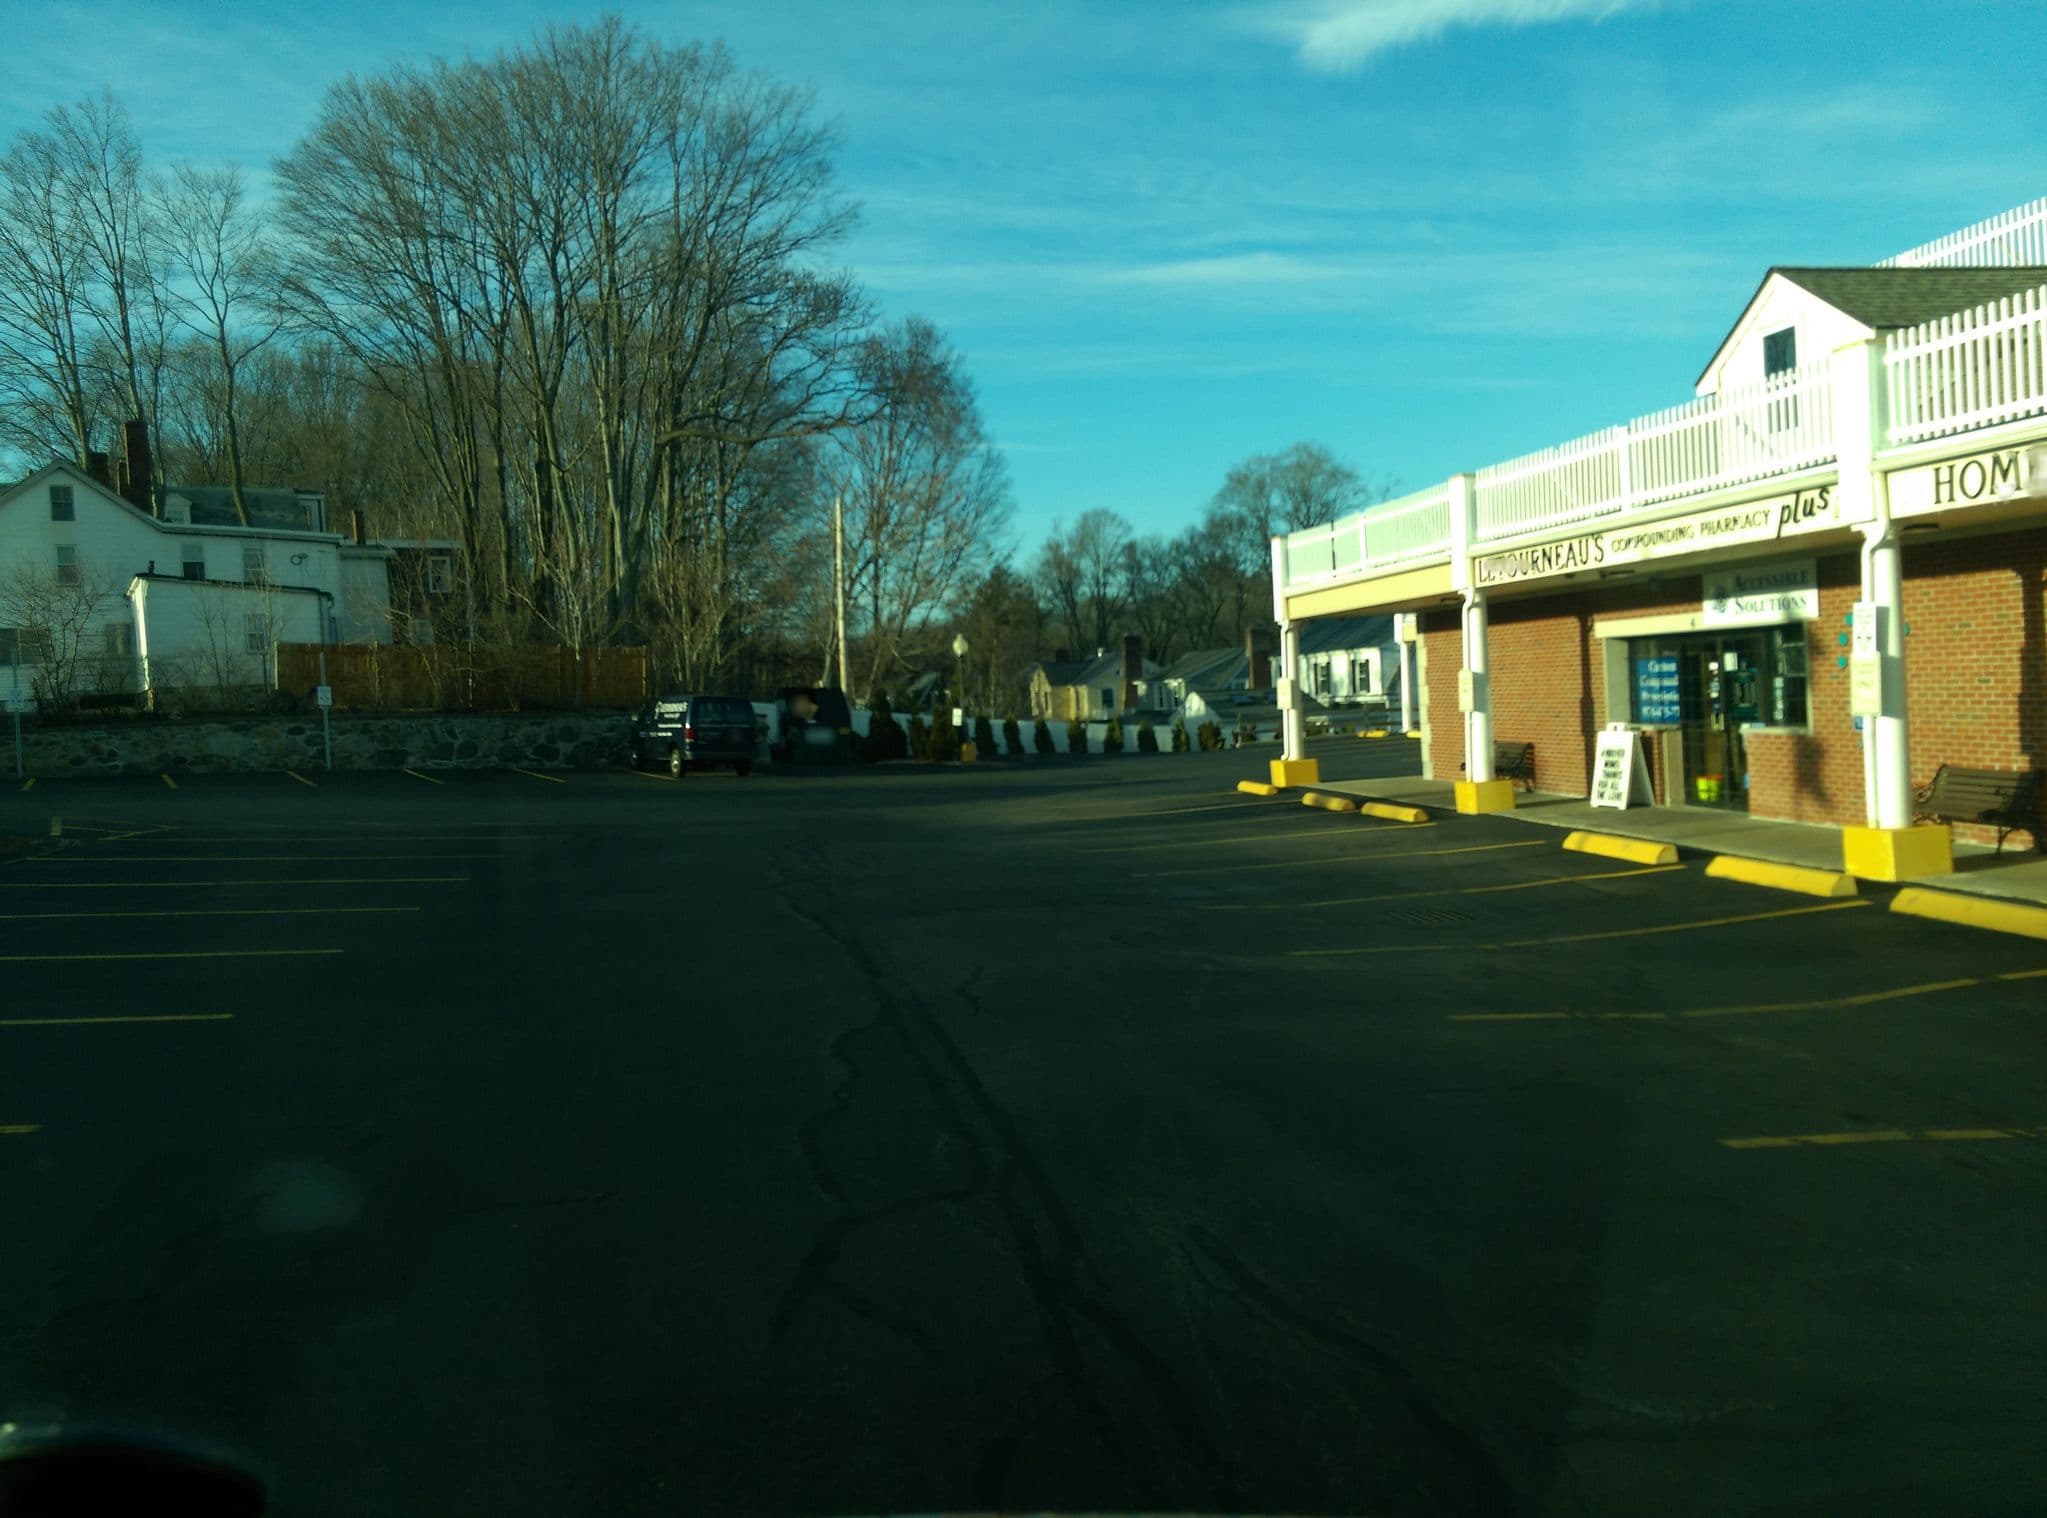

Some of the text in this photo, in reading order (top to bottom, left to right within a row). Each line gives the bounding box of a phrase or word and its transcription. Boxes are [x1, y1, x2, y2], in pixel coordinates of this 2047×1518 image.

[1933, 446, 2046, 505] HOM
[1611, 525, 1695, 553] COMPOUNDING
[1700, 509, 1771, 536] PHARMACY
[1776, 486, 1831, 540] plus
